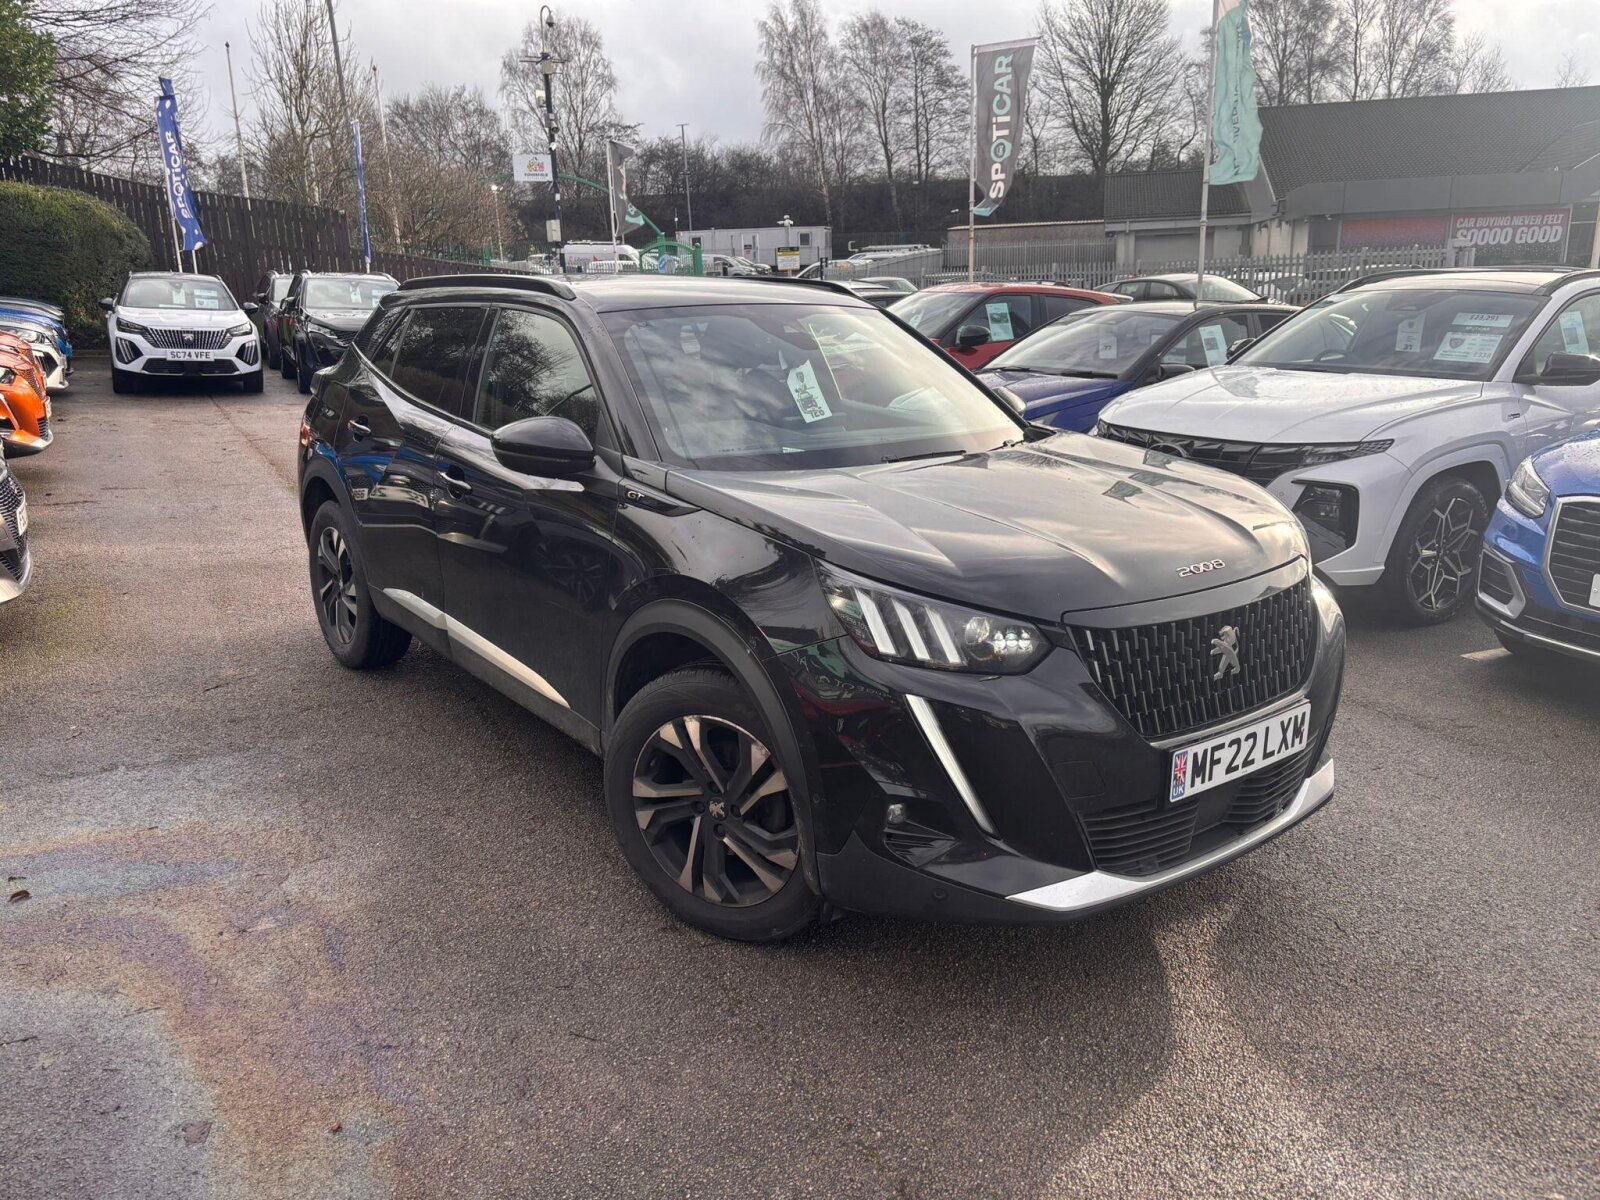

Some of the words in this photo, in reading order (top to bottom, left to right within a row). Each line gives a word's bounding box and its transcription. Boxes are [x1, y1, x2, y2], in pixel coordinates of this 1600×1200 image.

[1456, 217, 1475, 228] CAR
[1476, 216, 1511, 227] BUYING
[1512, 215, 1541, 225] NEVER
[1543, 214, 1564, 224] FELT
[1515, 225, 1562, 244] GOOD
[170, 351, 192, 359] SC74
[194, 351, 211, 359] VFE
[627, 490, 645, 501] GT
[1175, 558, 1226, 577] 2008
[1172, 785, 1184, 796] UK
[1190, 731, 1258, 788] MF22
[1262, 711, 1306, 760] LXM
